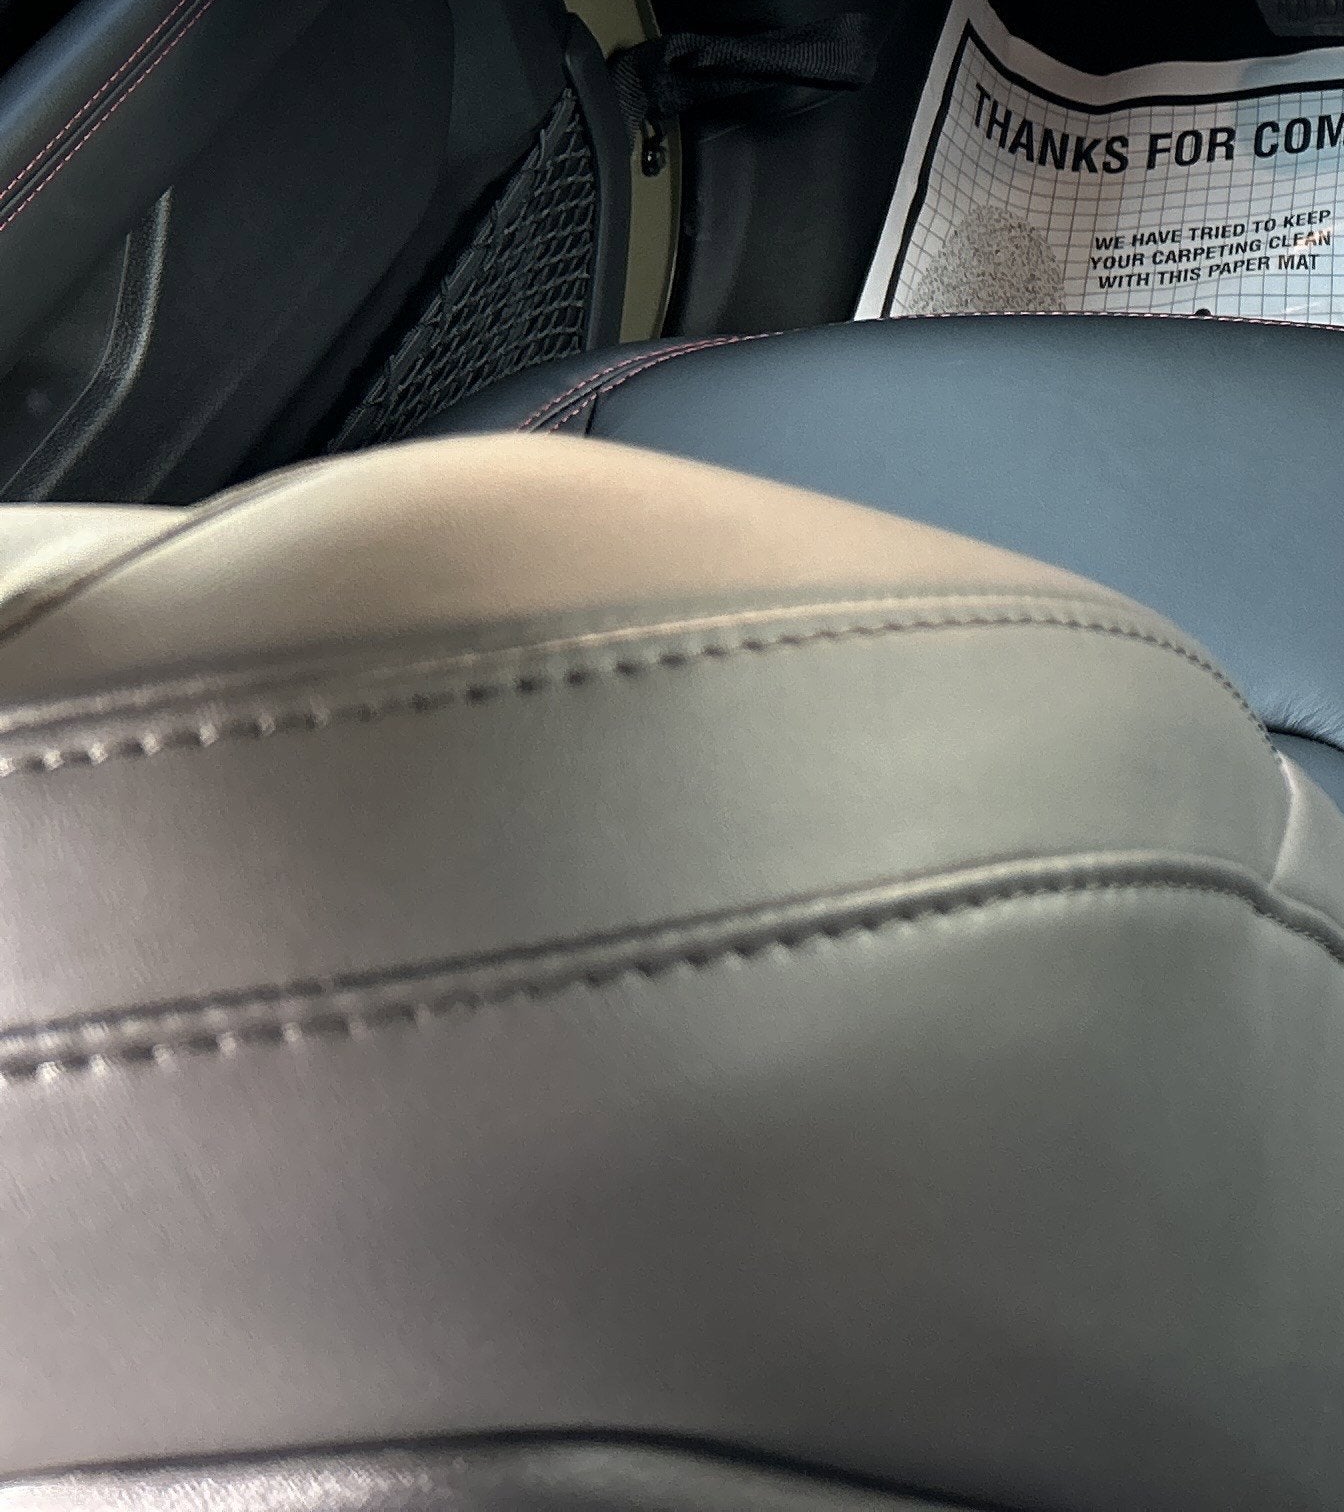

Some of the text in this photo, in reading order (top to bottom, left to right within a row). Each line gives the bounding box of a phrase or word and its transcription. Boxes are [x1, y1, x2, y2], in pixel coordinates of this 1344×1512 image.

[975, 82, 1130, 175] THANKS
[1146, 127, 1237, 170] FOR
[1089, 230, 1332, 271] YOUR CARPETING CLEAN
[1094, 208, 1331, 251] WE HAVE TRIED TO KEEP
[1097, 254, 1320, 289] WITH THIS PAPER MAT
